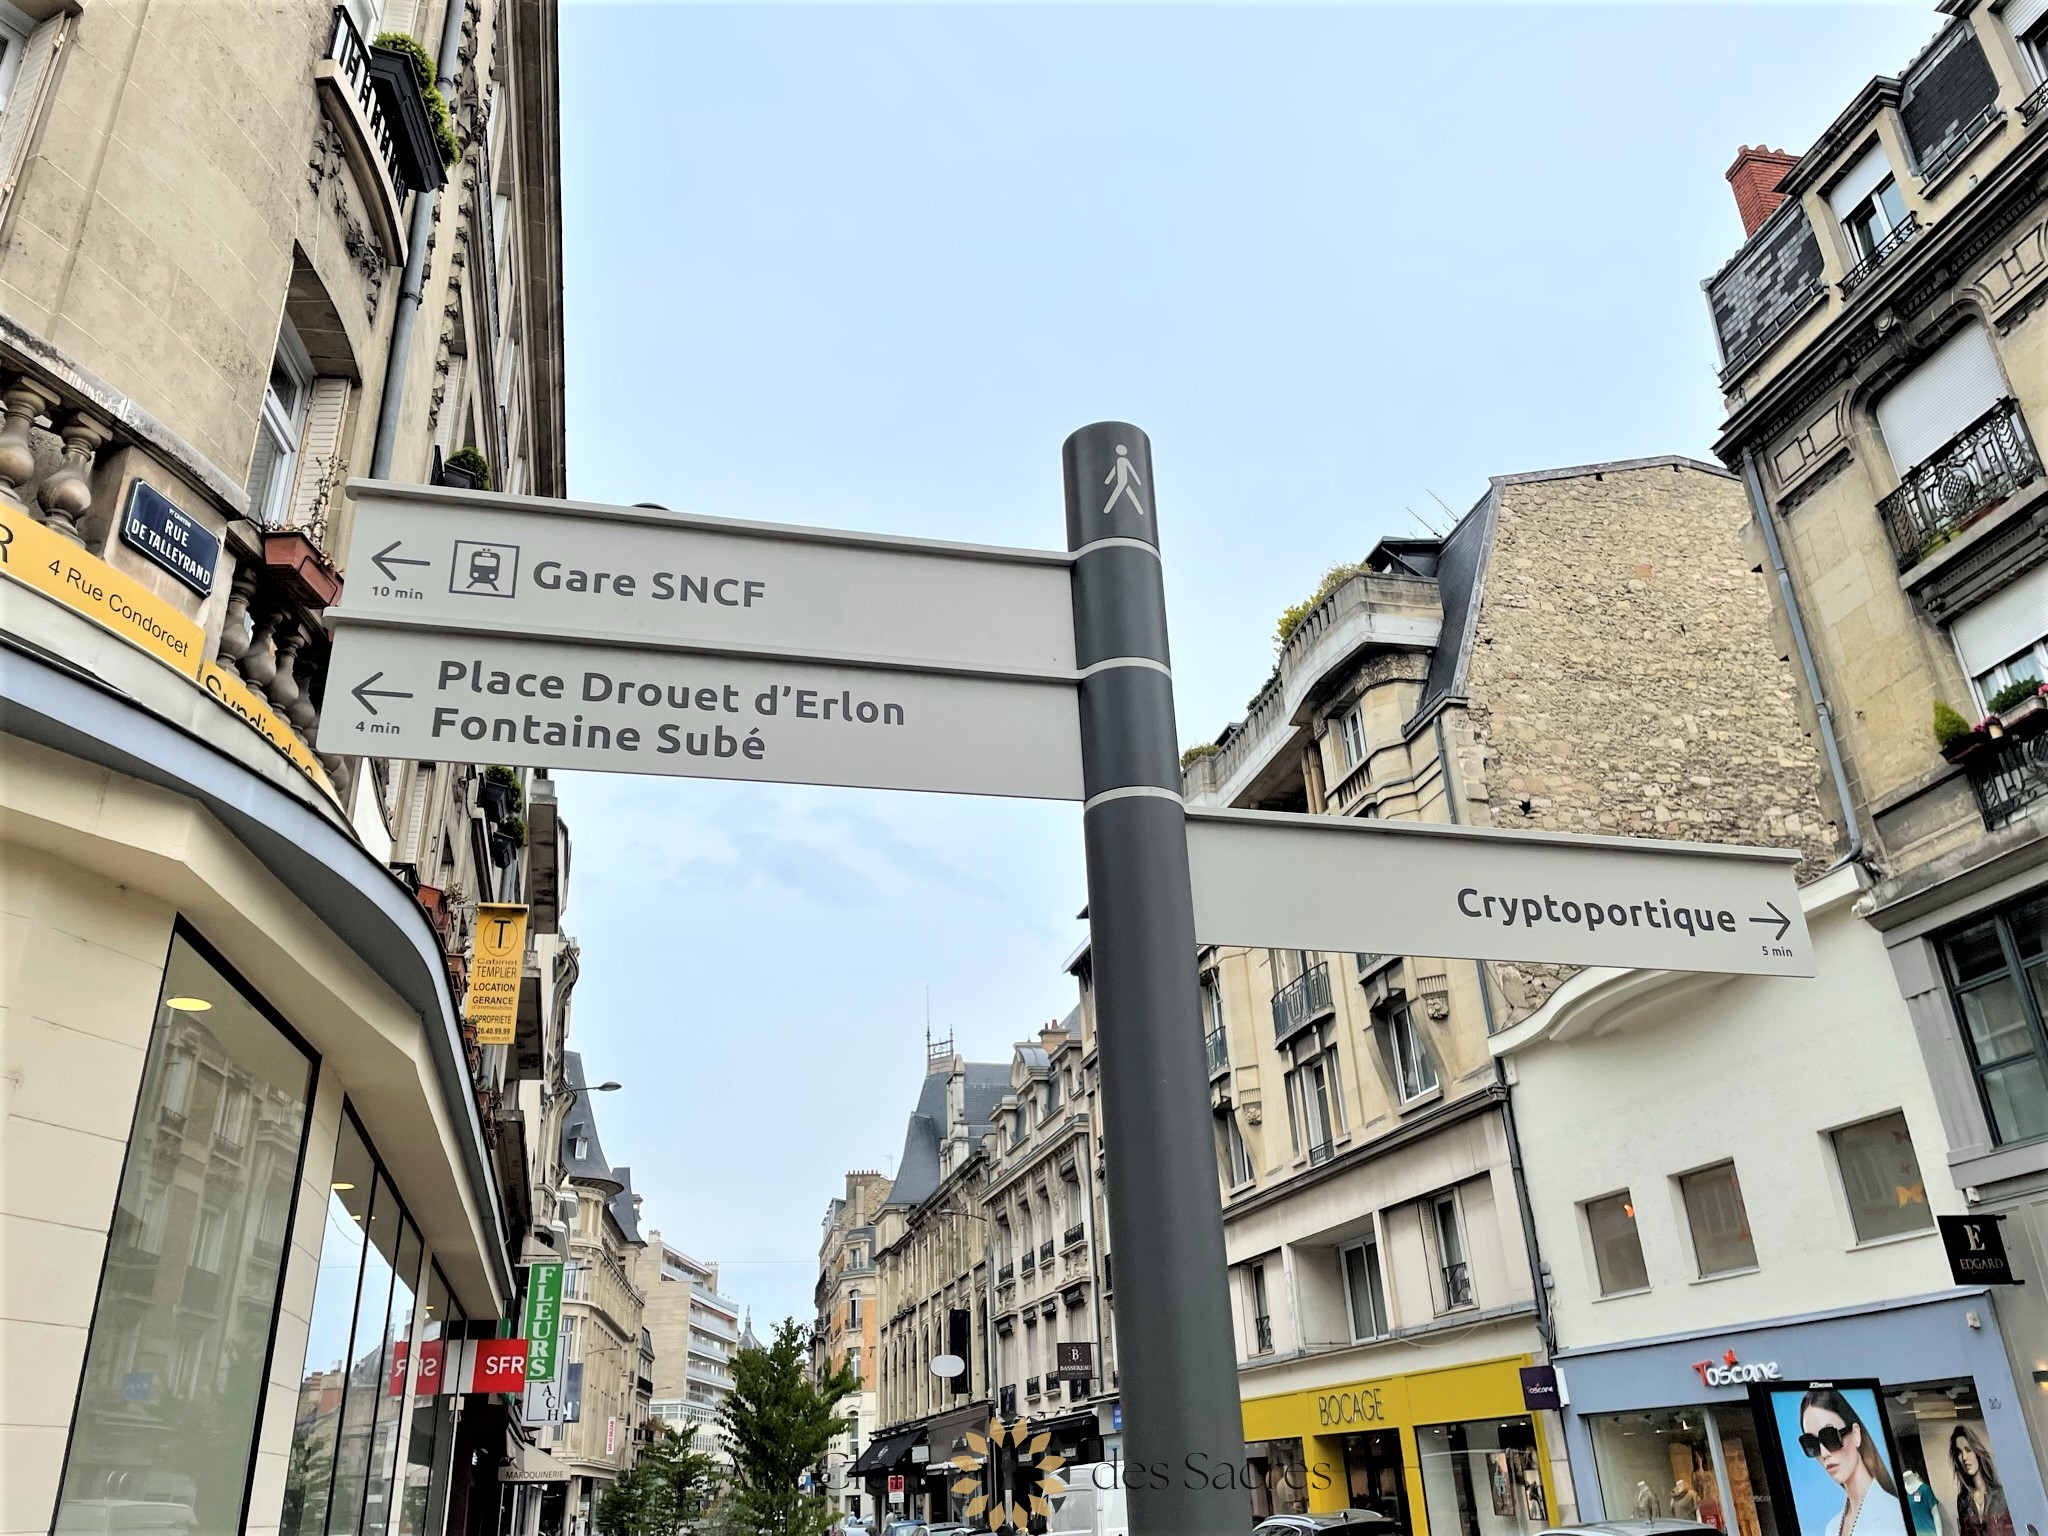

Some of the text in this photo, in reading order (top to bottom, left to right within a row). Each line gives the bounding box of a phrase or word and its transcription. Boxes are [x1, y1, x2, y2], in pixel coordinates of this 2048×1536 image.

[164, 519, 190, 547] RUE
[131, 519, 211, 585] DE TALLEYRAND
[371, 586, 424, 600] 10 min
[532, 561, 766, 608] Gare SNCF
[48, 560, 189, 658] 4 Rue Condorcet
[437, 660, 566, 701] Place
[581, 672, 738, 713] Drouet
[356, 722, 401, 735] 4 min
[431, 707, 766, 760] Fontaine Subé
[1457, 888, 1737, 936] Cryptoportique
[477, 958, 518, 967] Cabinet
[1762, 946, 1793, 957] 5 min
[476, 966, 517, 979] TEMPLIER
[473, 982, 516, 993] LOCATION
[472, 996, 514, 1005] GERANCE
[1963, 1224, 1985, 1251] E
[1960, 1258, 2004, 1270] EDGARD
[529, 1266, 557, 1377] FLEURS
[485, 1356, 525, 1375] SFR
[1071, 1348, 1080, 1361] B
[1692, 1360, 1783, 1387] Toscane
[1319, 1388, 1385, 1426] BOCAGE
[506, 1471, 564, 1480] MAROQUINERIE
